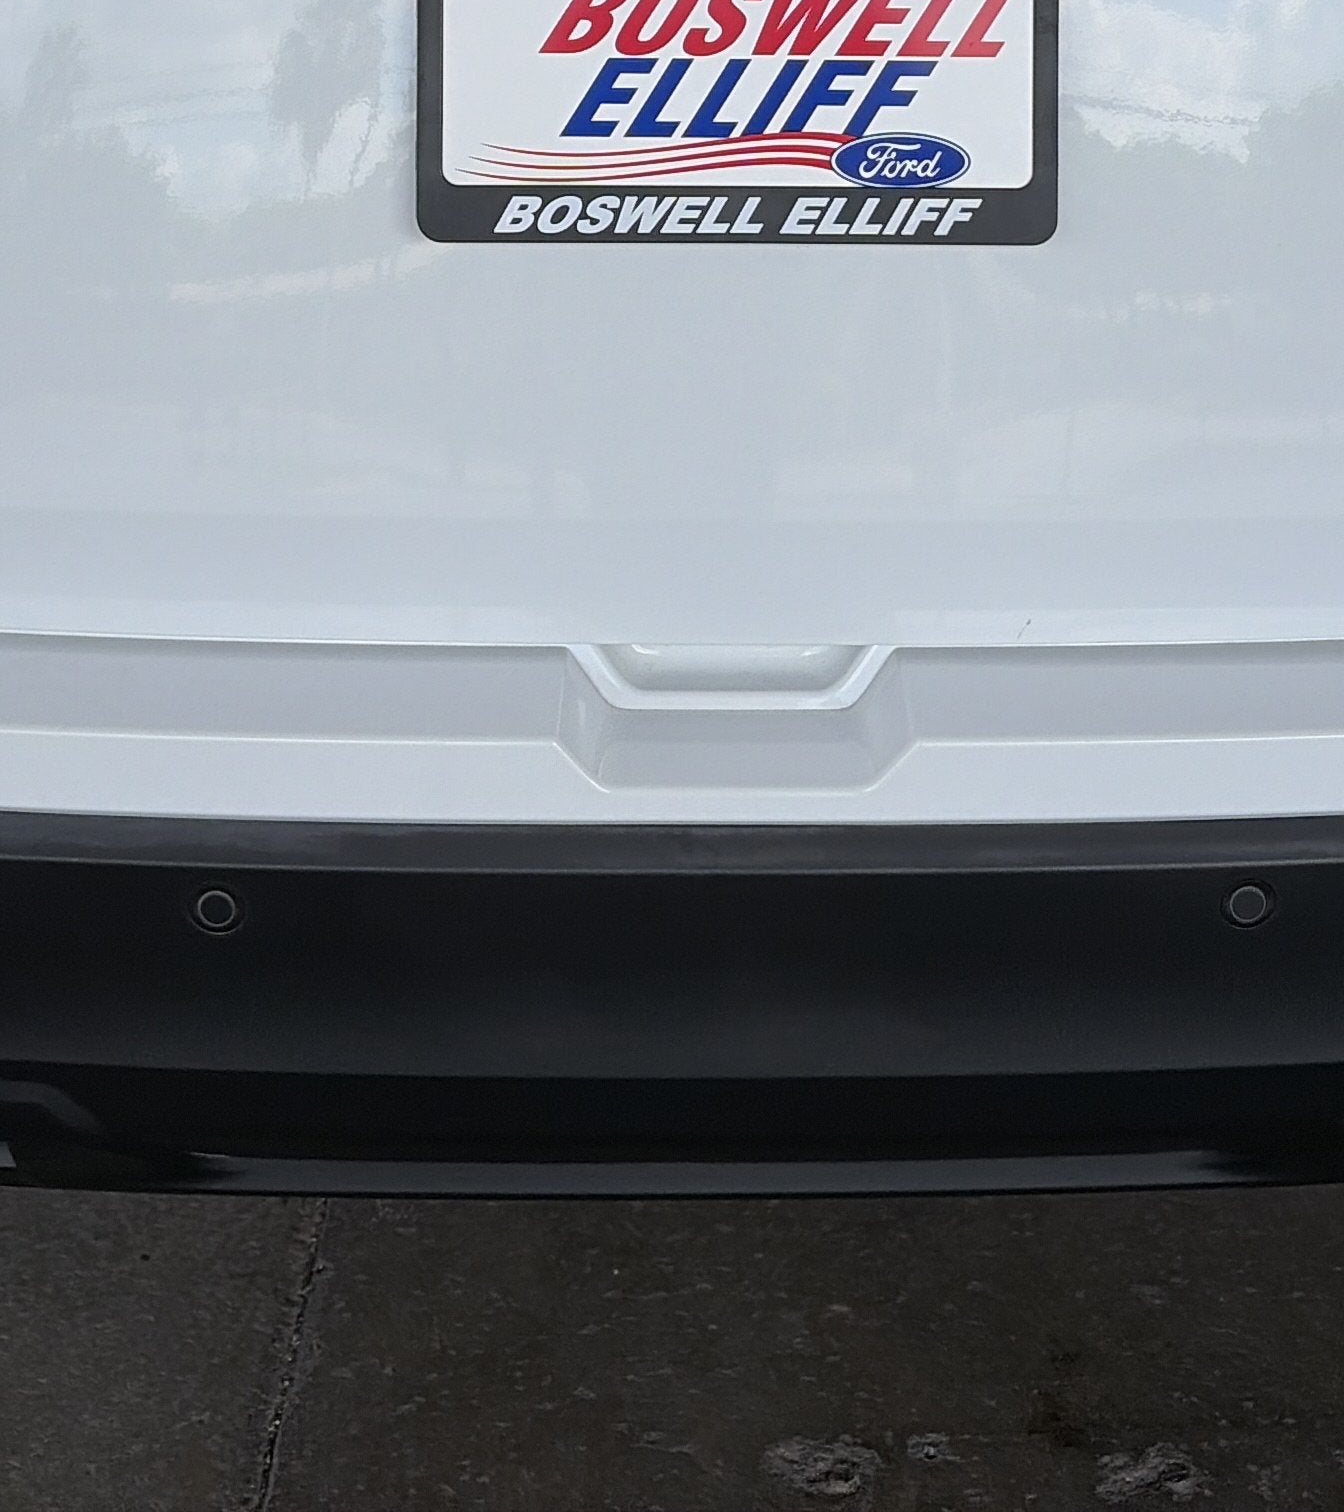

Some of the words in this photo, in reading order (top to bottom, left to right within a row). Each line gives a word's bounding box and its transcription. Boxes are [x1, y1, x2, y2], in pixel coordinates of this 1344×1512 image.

[559, 58, 938, 138] ELLIFF
[858, 142, 941, 178] Ford
[493, 195, 765, 235] BOSWELL
[778, 199, 982, 237] ELLIFF
